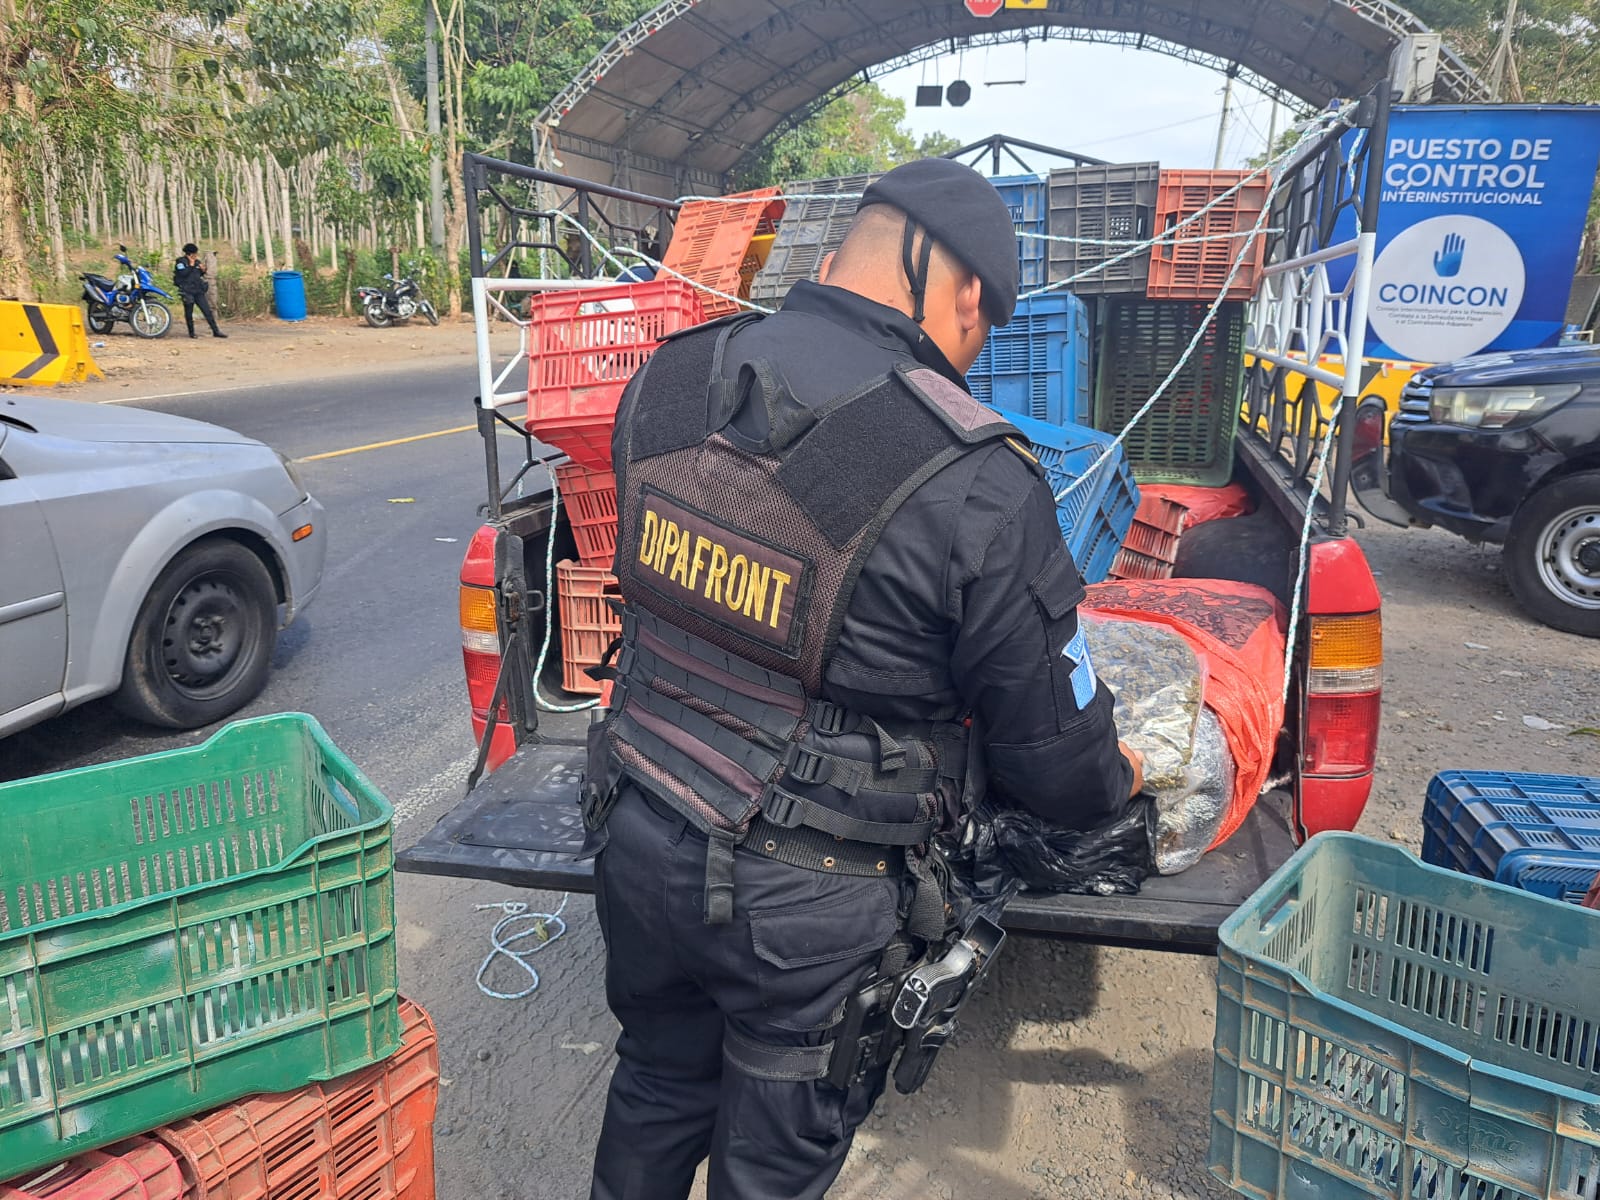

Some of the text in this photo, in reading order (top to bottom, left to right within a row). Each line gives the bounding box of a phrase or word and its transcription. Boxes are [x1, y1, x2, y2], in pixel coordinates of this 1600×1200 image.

[1388, 138, 1552, 161] PUESTO DE
[1384, 163, 1545, 190] CONTROL
[1382, 190, 1543, 205] INTERINSTITUCIONAL
[1379, 283, 1508, 307] COINCON
[639, 510, 791, 629] DIPAFRONT
